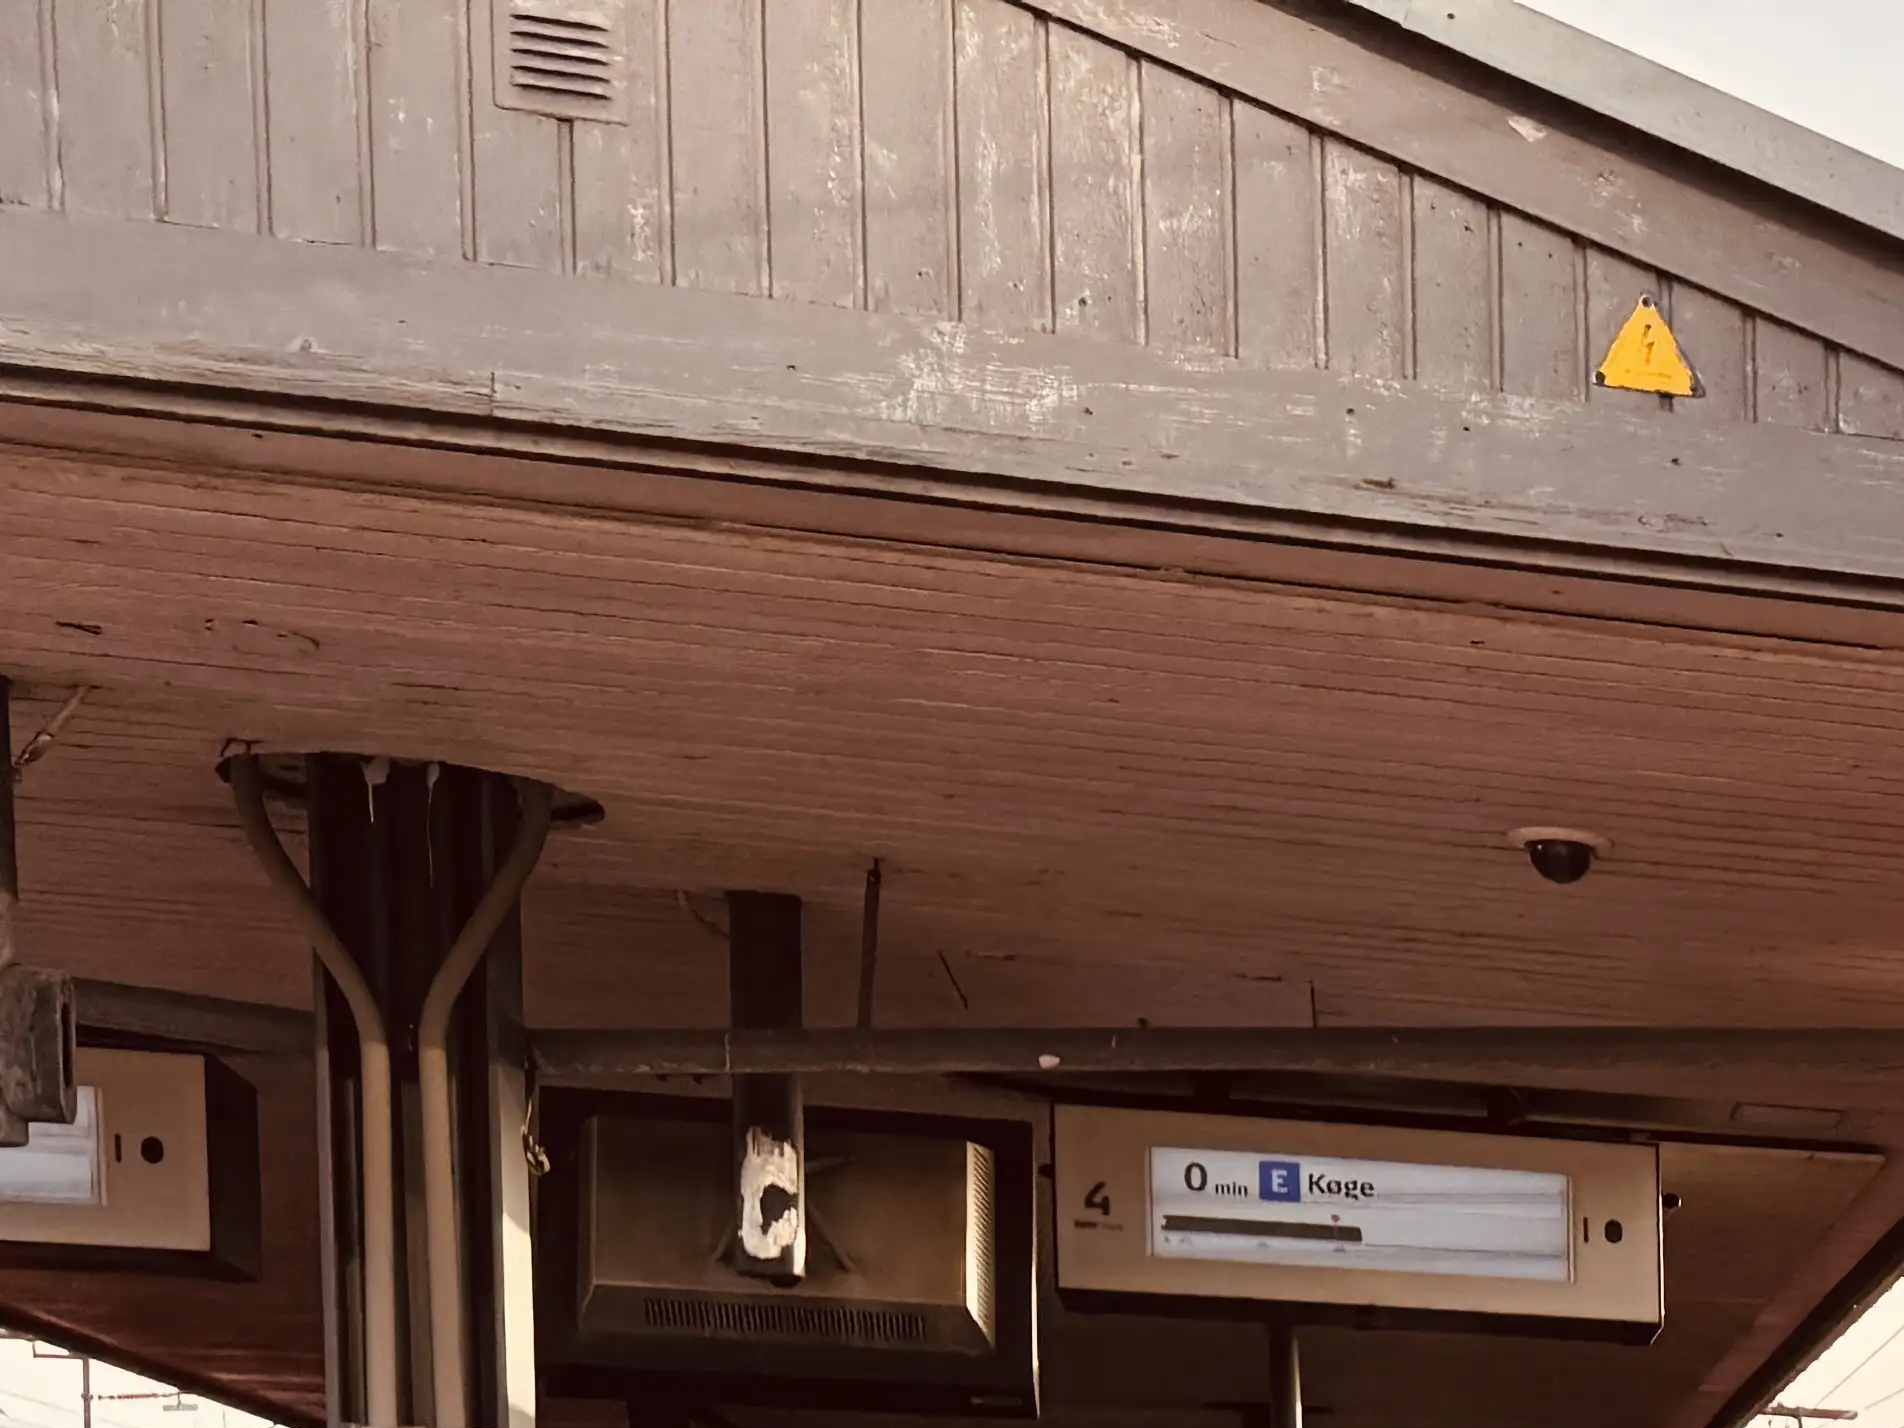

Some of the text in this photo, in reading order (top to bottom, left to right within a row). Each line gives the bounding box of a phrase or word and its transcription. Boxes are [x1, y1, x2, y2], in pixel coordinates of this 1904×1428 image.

[1084, 1181, 1111, 1217] 4
[1184, 1162, 1375, 1201] 0 min E Køge
